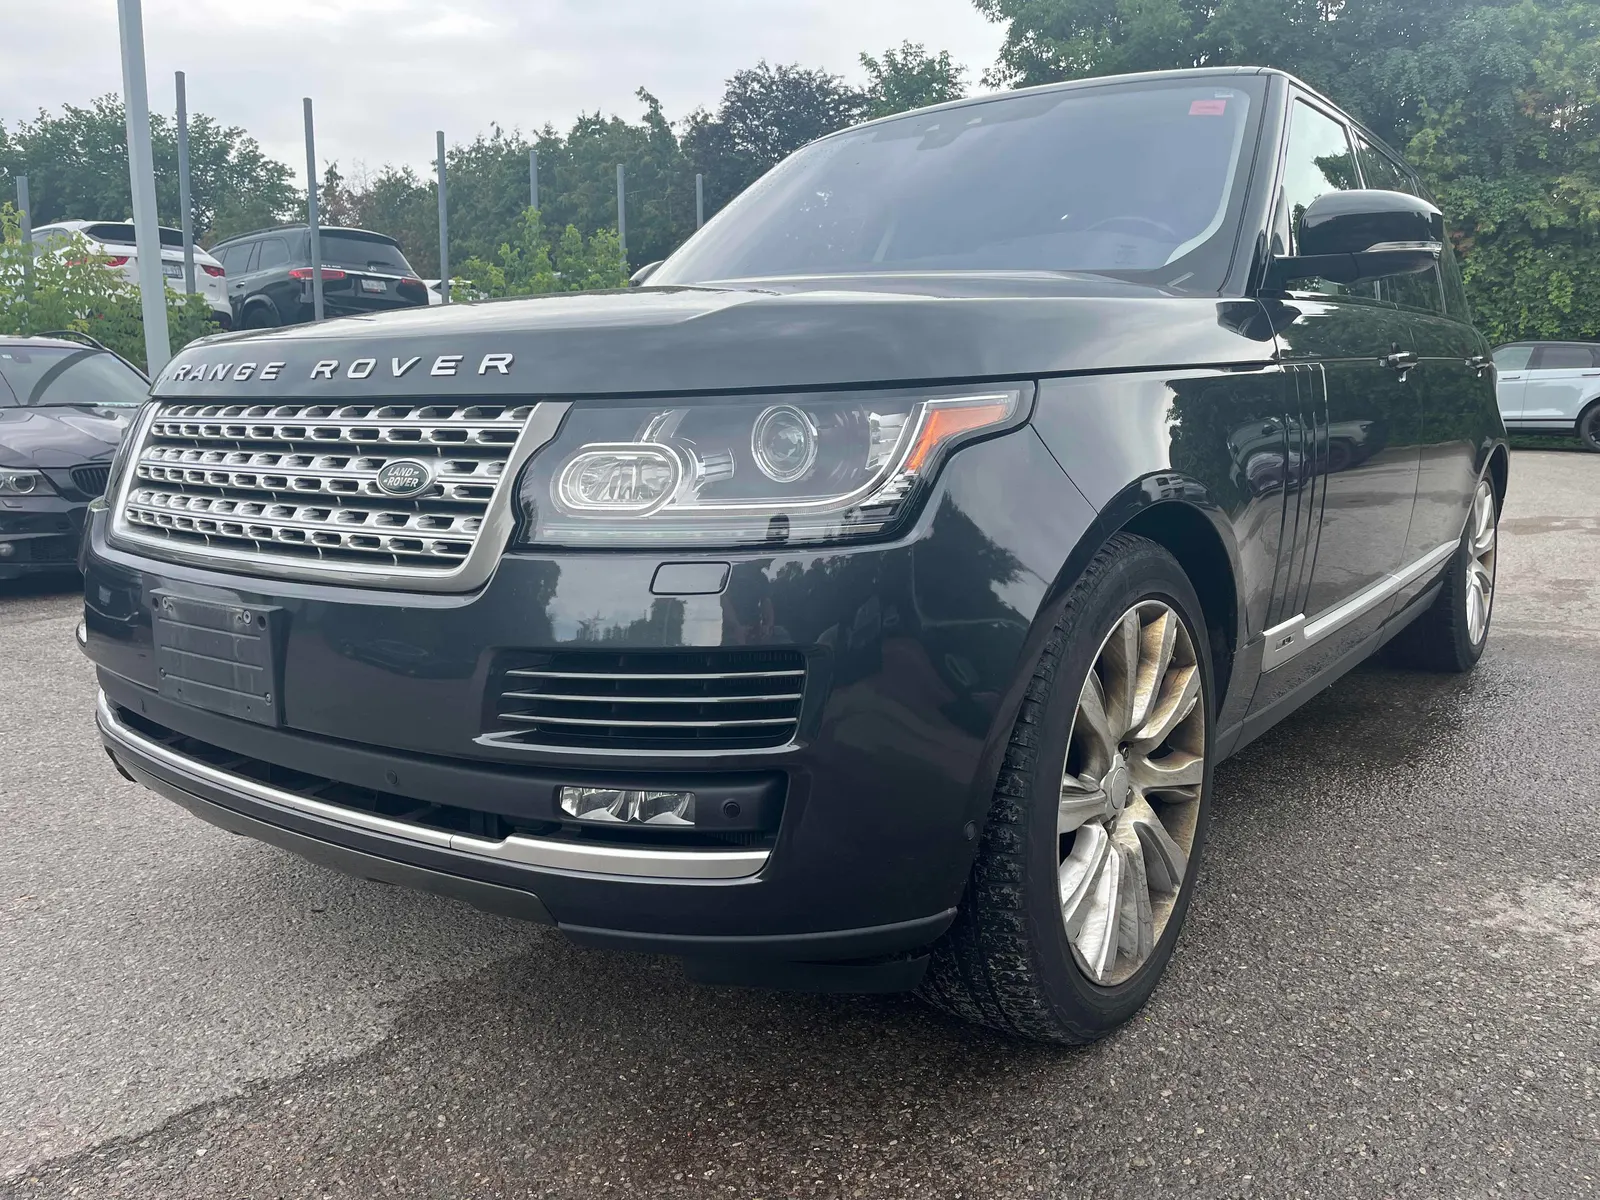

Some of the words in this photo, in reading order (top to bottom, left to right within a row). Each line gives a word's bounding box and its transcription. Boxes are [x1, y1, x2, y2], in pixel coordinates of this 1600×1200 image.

[172, 361, 286, 381] RANGE
[309, 353, 514, 379] ROVER
[387, 467, 414, 477] LAND
[387, 476, 419, 488] ROVER
